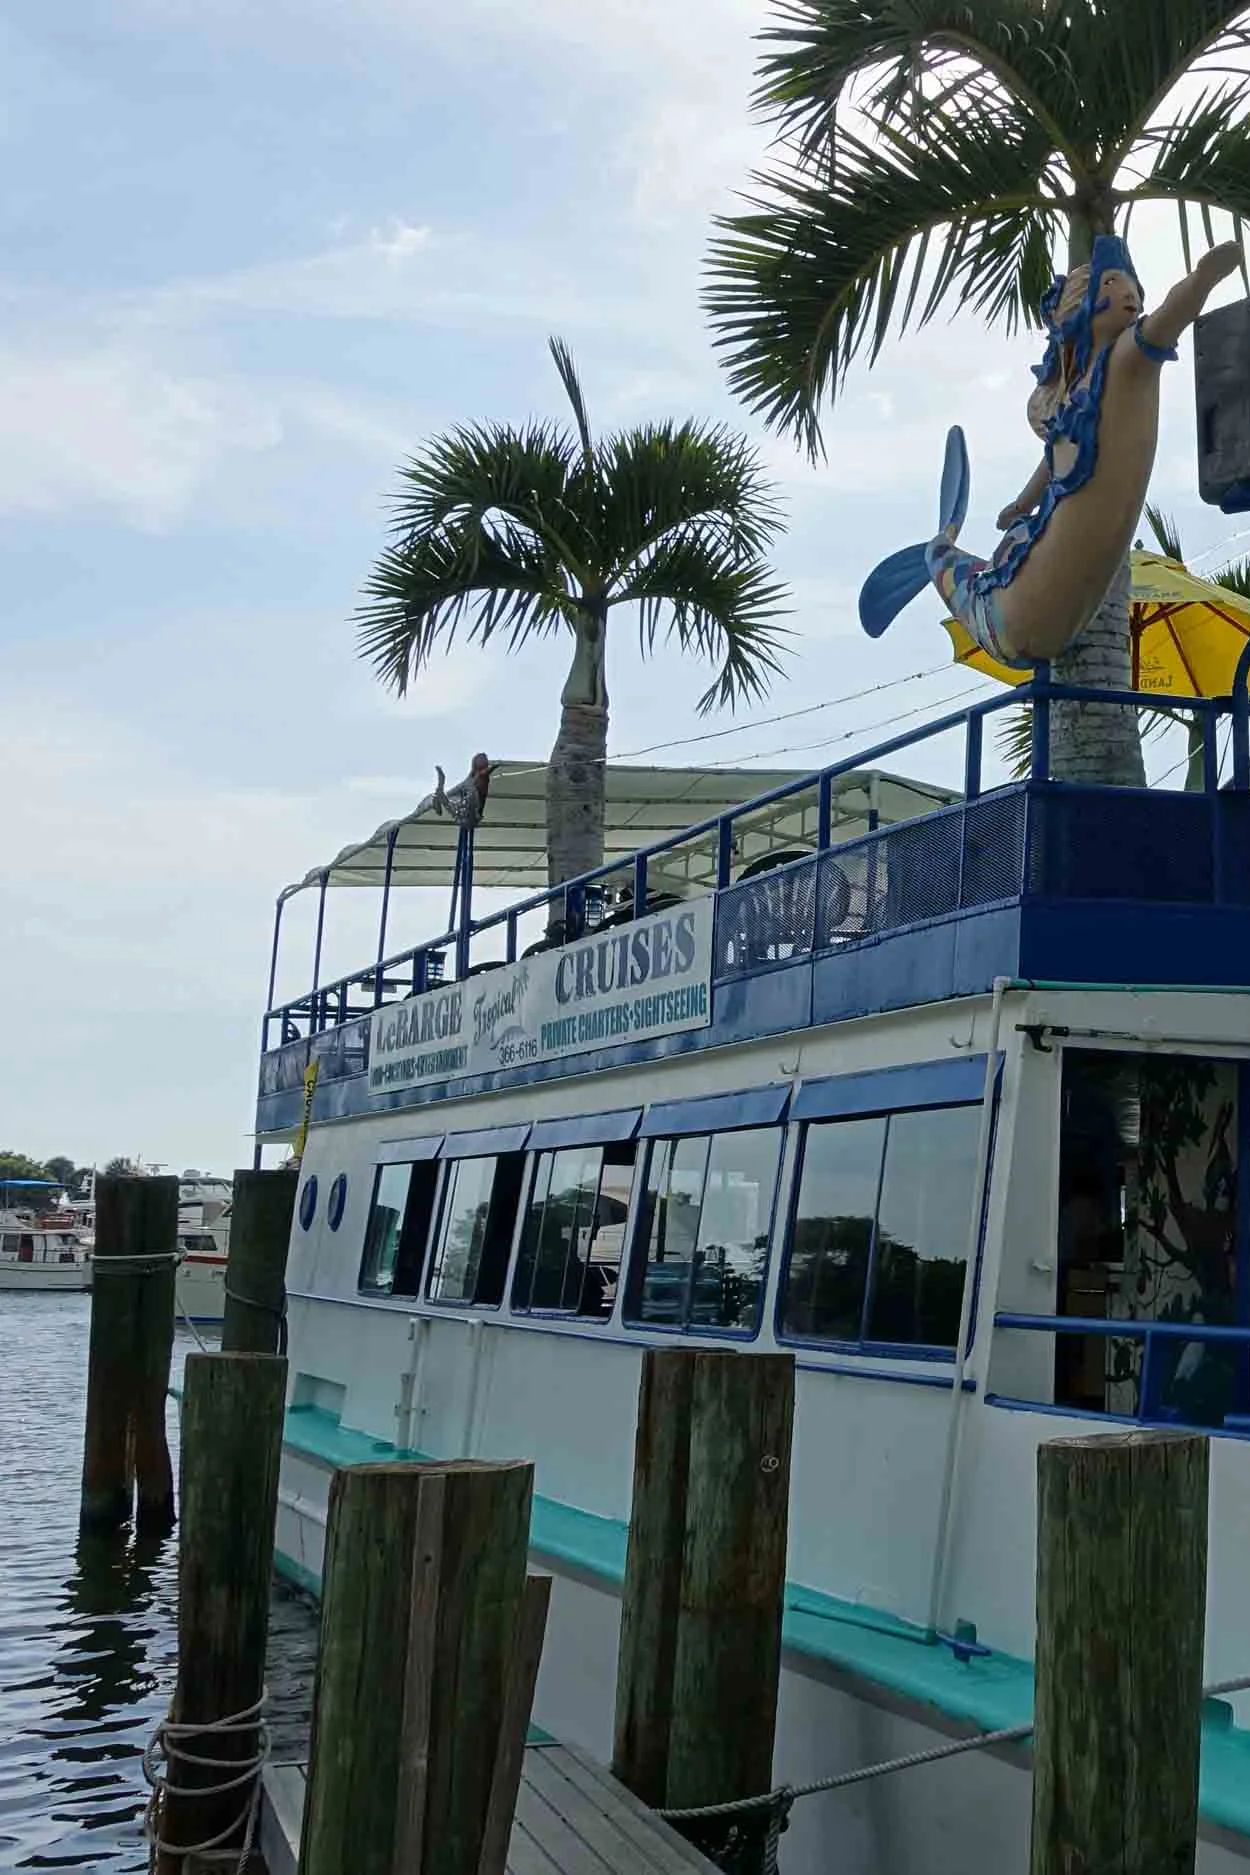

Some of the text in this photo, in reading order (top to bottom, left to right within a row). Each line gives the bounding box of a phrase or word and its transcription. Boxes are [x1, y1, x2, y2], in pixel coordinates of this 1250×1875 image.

[554, 912, 696, 1004] CRUISES
[376, 991, 463, 1053] LeBARGE
[473, 976, 516, 1045] Tropical
[541, 1017, 577, 1050] PRIVATE
